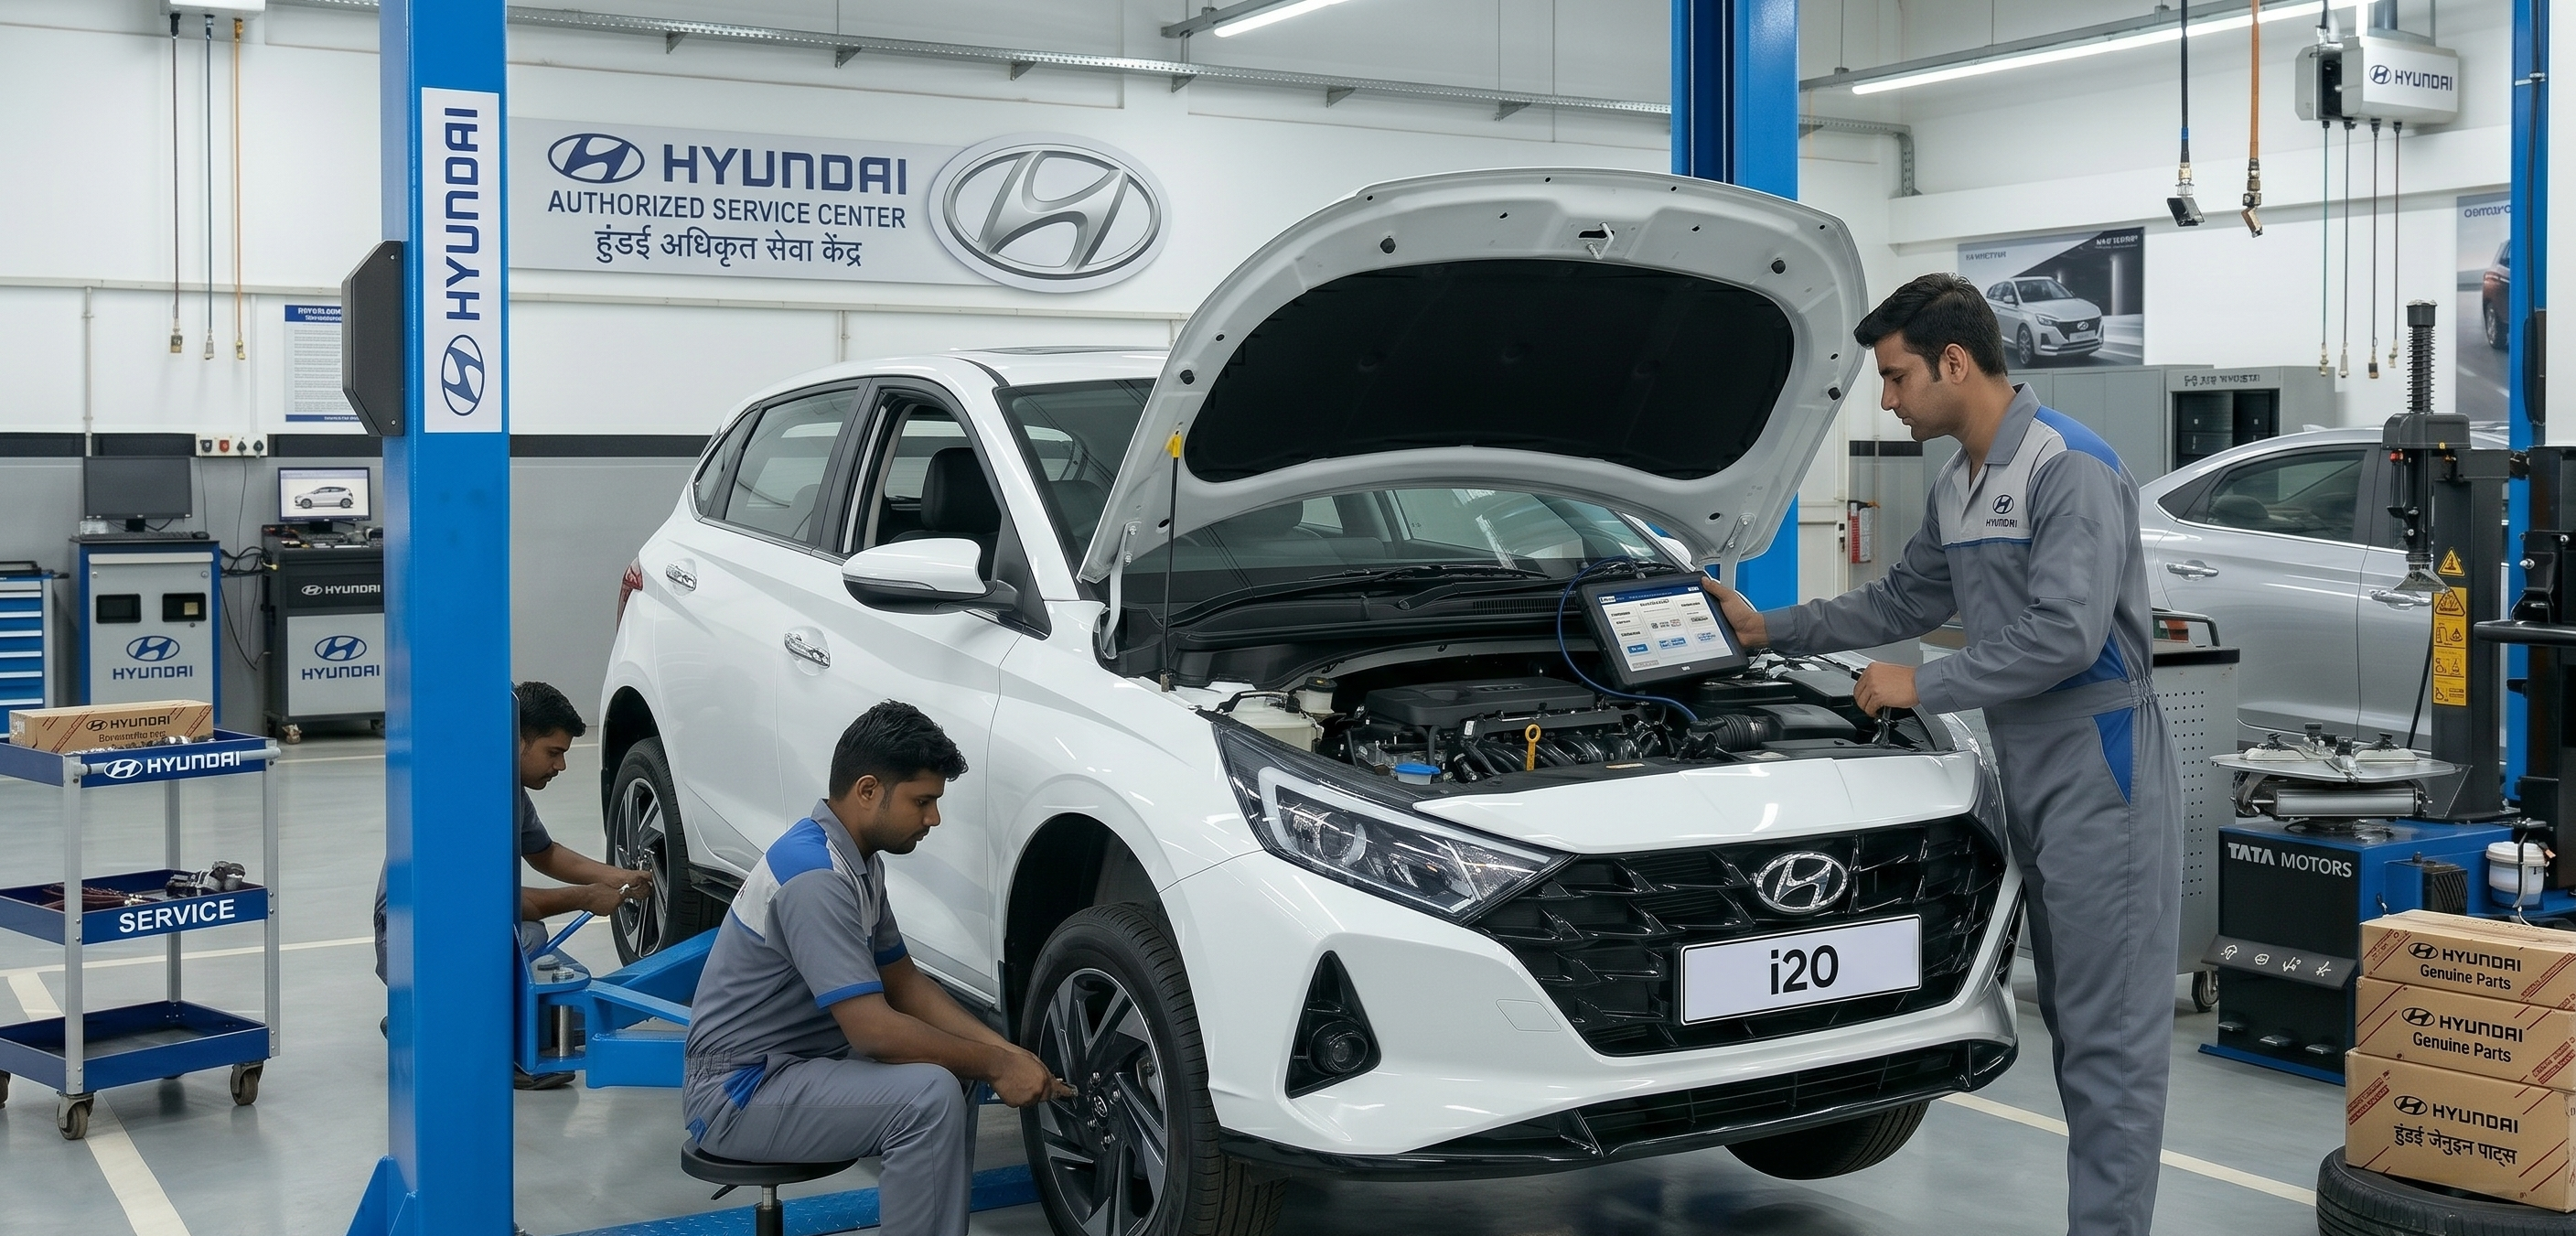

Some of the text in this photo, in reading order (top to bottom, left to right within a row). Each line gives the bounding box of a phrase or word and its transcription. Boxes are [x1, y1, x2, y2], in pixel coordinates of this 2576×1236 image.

[2395, 70, 2453, 91] HYUNDAI
[663, 144, 907, 195] HYUNDAI
[444, 107, 480, 321] HYUNDAI
[548, 189, 906, 229] AUTHORIZED SERVICE CENTER
[595, 224, 862, 267] हुंडई अधिकृत सेवा केंद्र
[325, 585, 381, 595] HYUNDAI
[113, 665, 193, 680] HYUNDAI
[302, 664, 380, 680] HYUNDAI
[110, 715, 170, 729] HYUNDAI
[146, 751, 241, 773] HYUNDAI
[2227, 842, 2352, 878] TATA MOTORS
[119, 898, 236, 933] SERVICE
[1770, 945, 1839, 995] i20
[2442, 948, 2521, 973] HYUNDAI
[2420, 963, 2473, 984] Genuine
[2476, 972, 2511, 990] Parts
[2440, 1015, 2523, 1043] HYUNDAI
[2413, 1031, 2470, 1052] Genuine
[2474, 1043, 2512, 1062] Parts
[2432, 1103, 2518, 1134] HYUNDAI
[2394, 1123, 2424, 1146] हुंडई
[2427, 1128, 2474, 1155] जेनुइन
